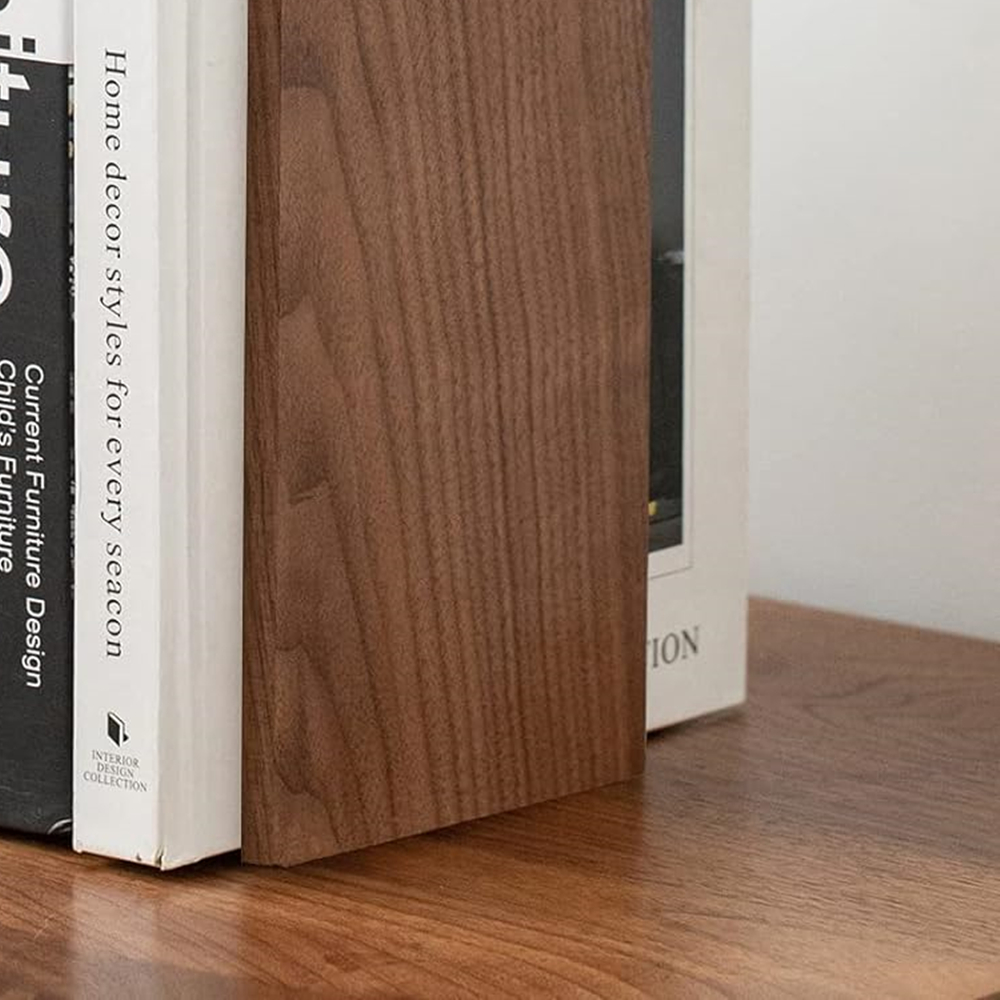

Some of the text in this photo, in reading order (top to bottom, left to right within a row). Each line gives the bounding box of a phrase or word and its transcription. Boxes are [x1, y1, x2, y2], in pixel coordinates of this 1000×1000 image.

[99, 48, 129, 659] Home decor styles for every seacon
[21, 363, 46, 688] Current Furniture Design
[646, 625, 700, 669] ION
[91, 750, 140, 769] INTERIOR
[96, 761, 134, 779] DESIGN
[83, 770, 148, 793] COLLECTION
